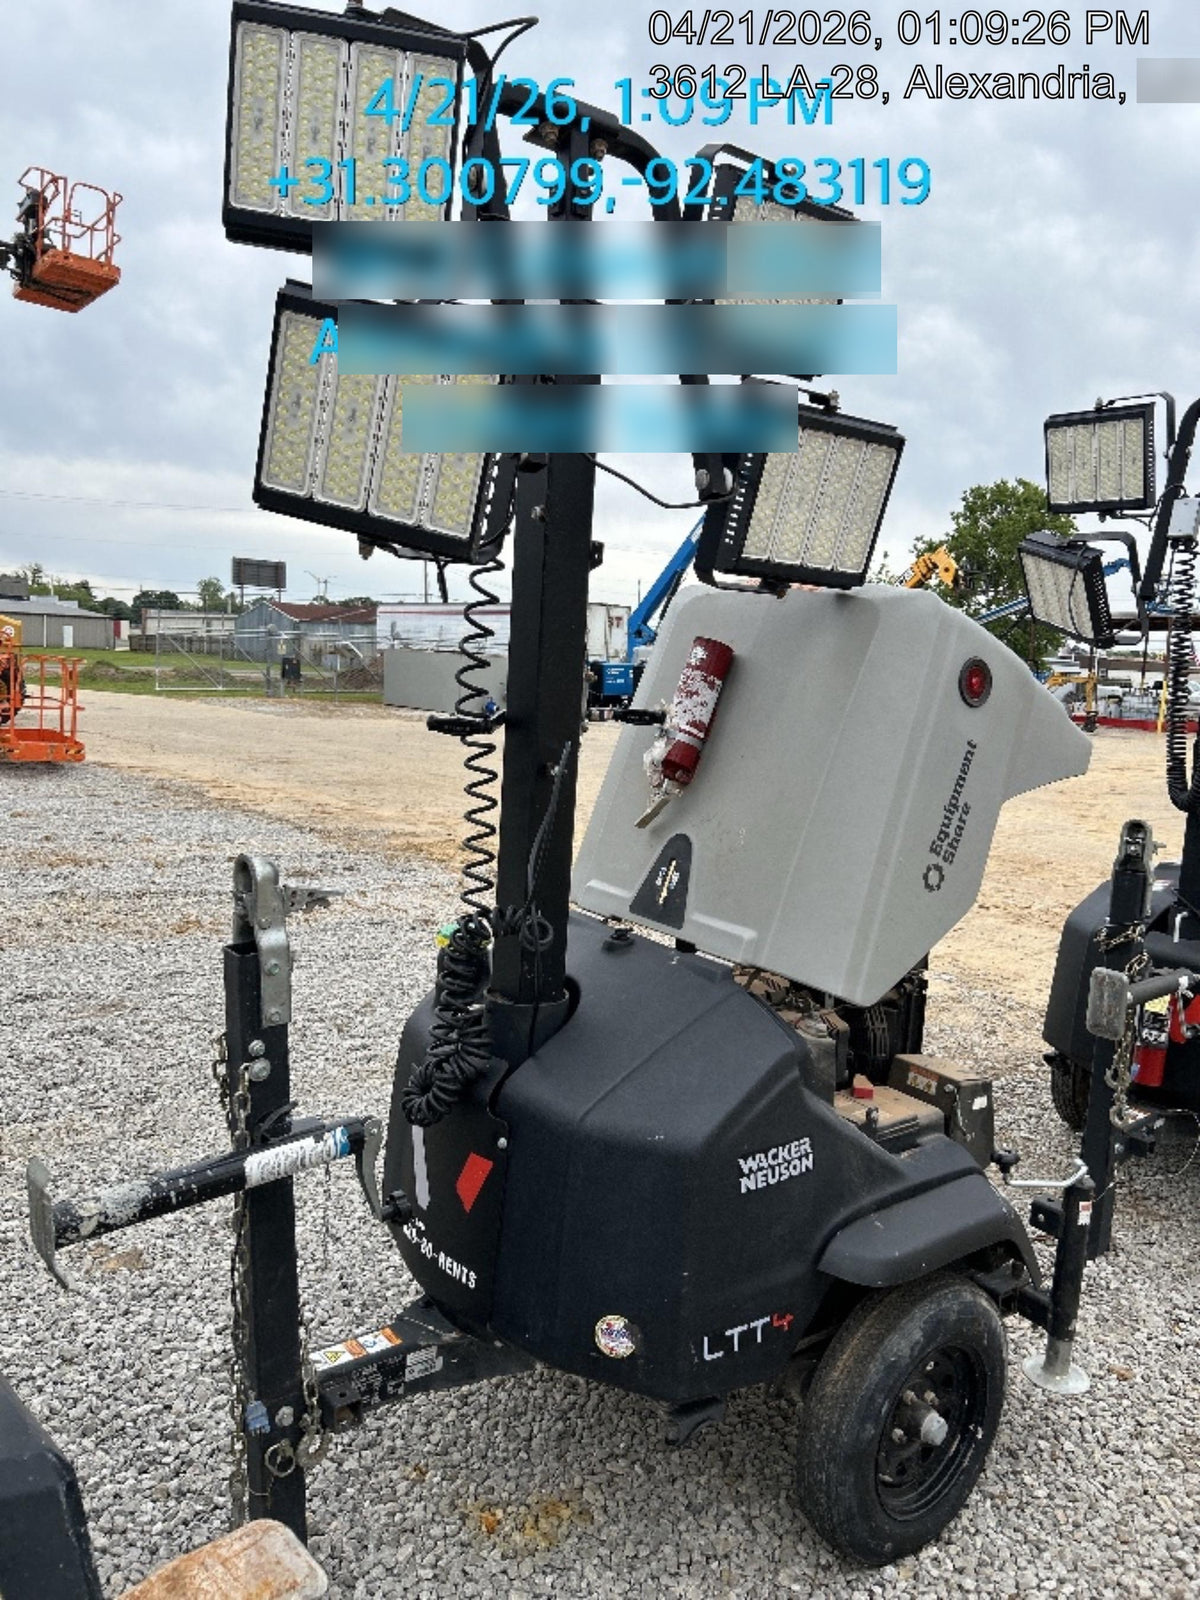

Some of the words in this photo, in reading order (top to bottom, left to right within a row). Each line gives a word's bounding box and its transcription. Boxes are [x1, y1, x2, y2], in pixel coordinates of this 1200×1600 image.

[929, 739, 978, 857] Equipment
[942, 802, 972, 865] Share
[737, 1136, 814, 1175] WACKER
[739, 1153, 814, 1194] NEUSON
